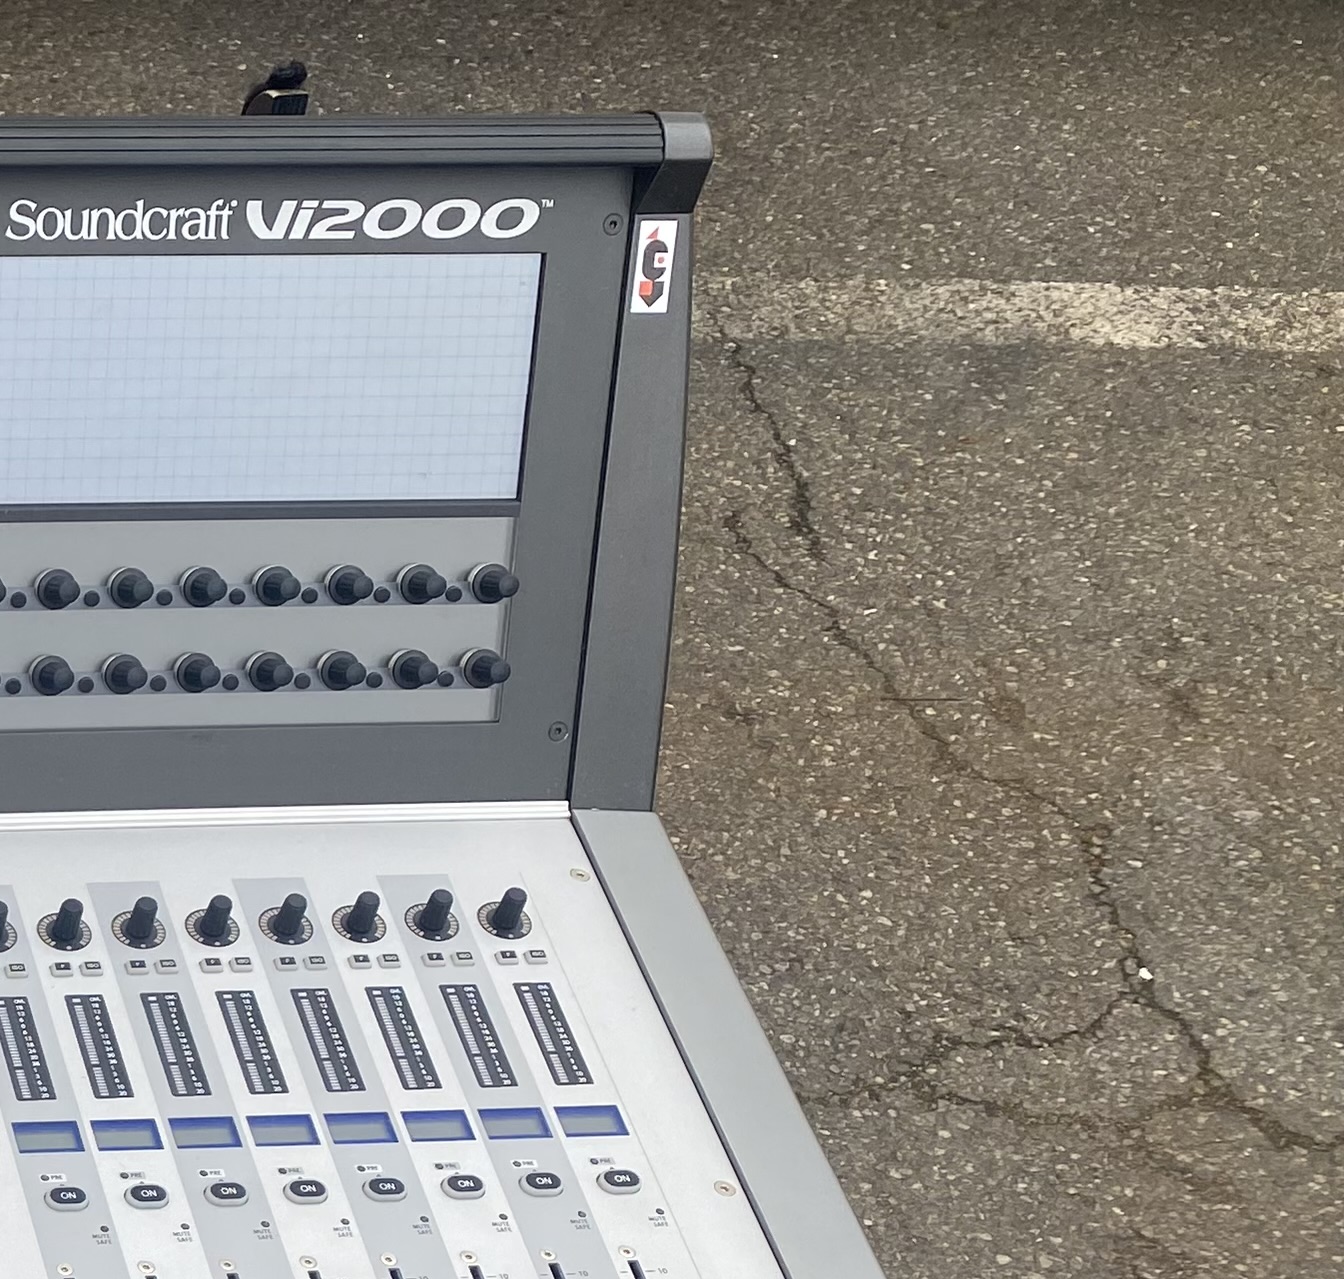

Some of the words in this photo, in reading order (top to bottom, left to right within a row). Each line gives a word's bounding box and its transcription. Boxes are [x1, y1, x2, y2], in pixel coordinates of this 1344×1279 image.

[5, 198, 238, 241] Soundcraft
[614, 1175, 630, 1183] ON
[221, 1187, 237, 1195] ON
[300, 1184, 316, 1193] ON
[379, 1183, 395, 1191] ON
[60, 1191, 76, 1199] ON
